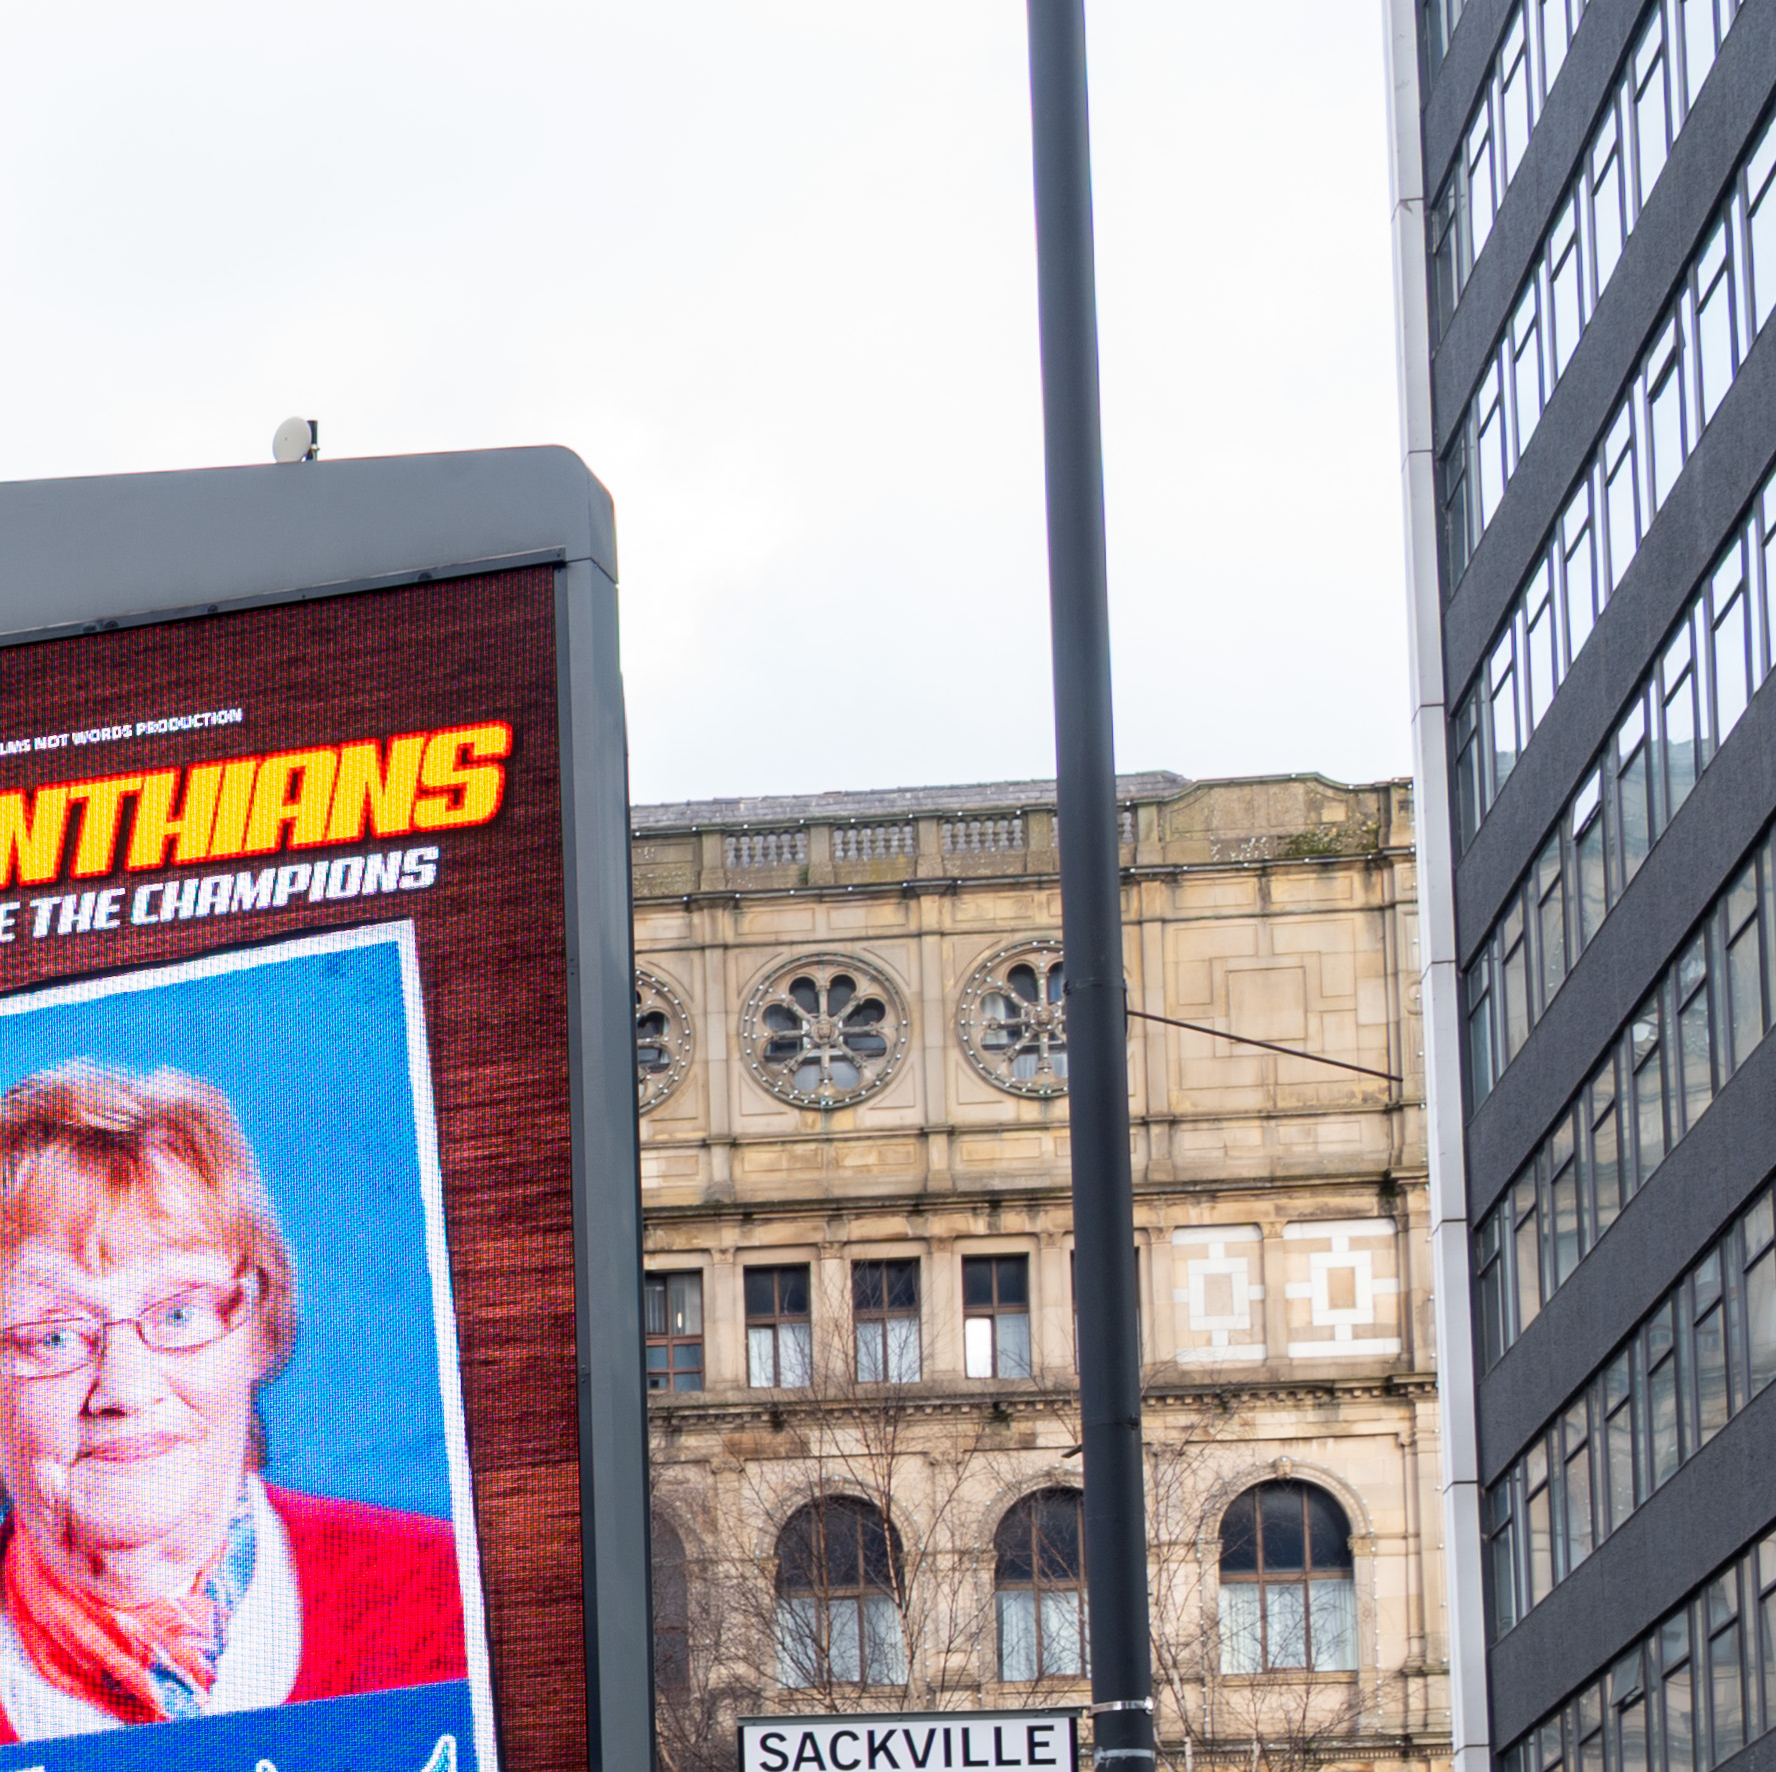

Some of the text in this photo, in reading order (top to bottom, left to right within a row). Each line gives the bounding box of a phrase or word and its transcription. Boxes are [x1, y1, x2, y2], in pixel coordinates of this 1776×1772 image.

[34, 733, 69, 750] NOT
[72, 724, 133, 745] WORDS
[136, 708, 243, 736] PRODUCTION
[30, 882, 125, 937] THE
[129, 846, 441, 926] CHAMPIONS
